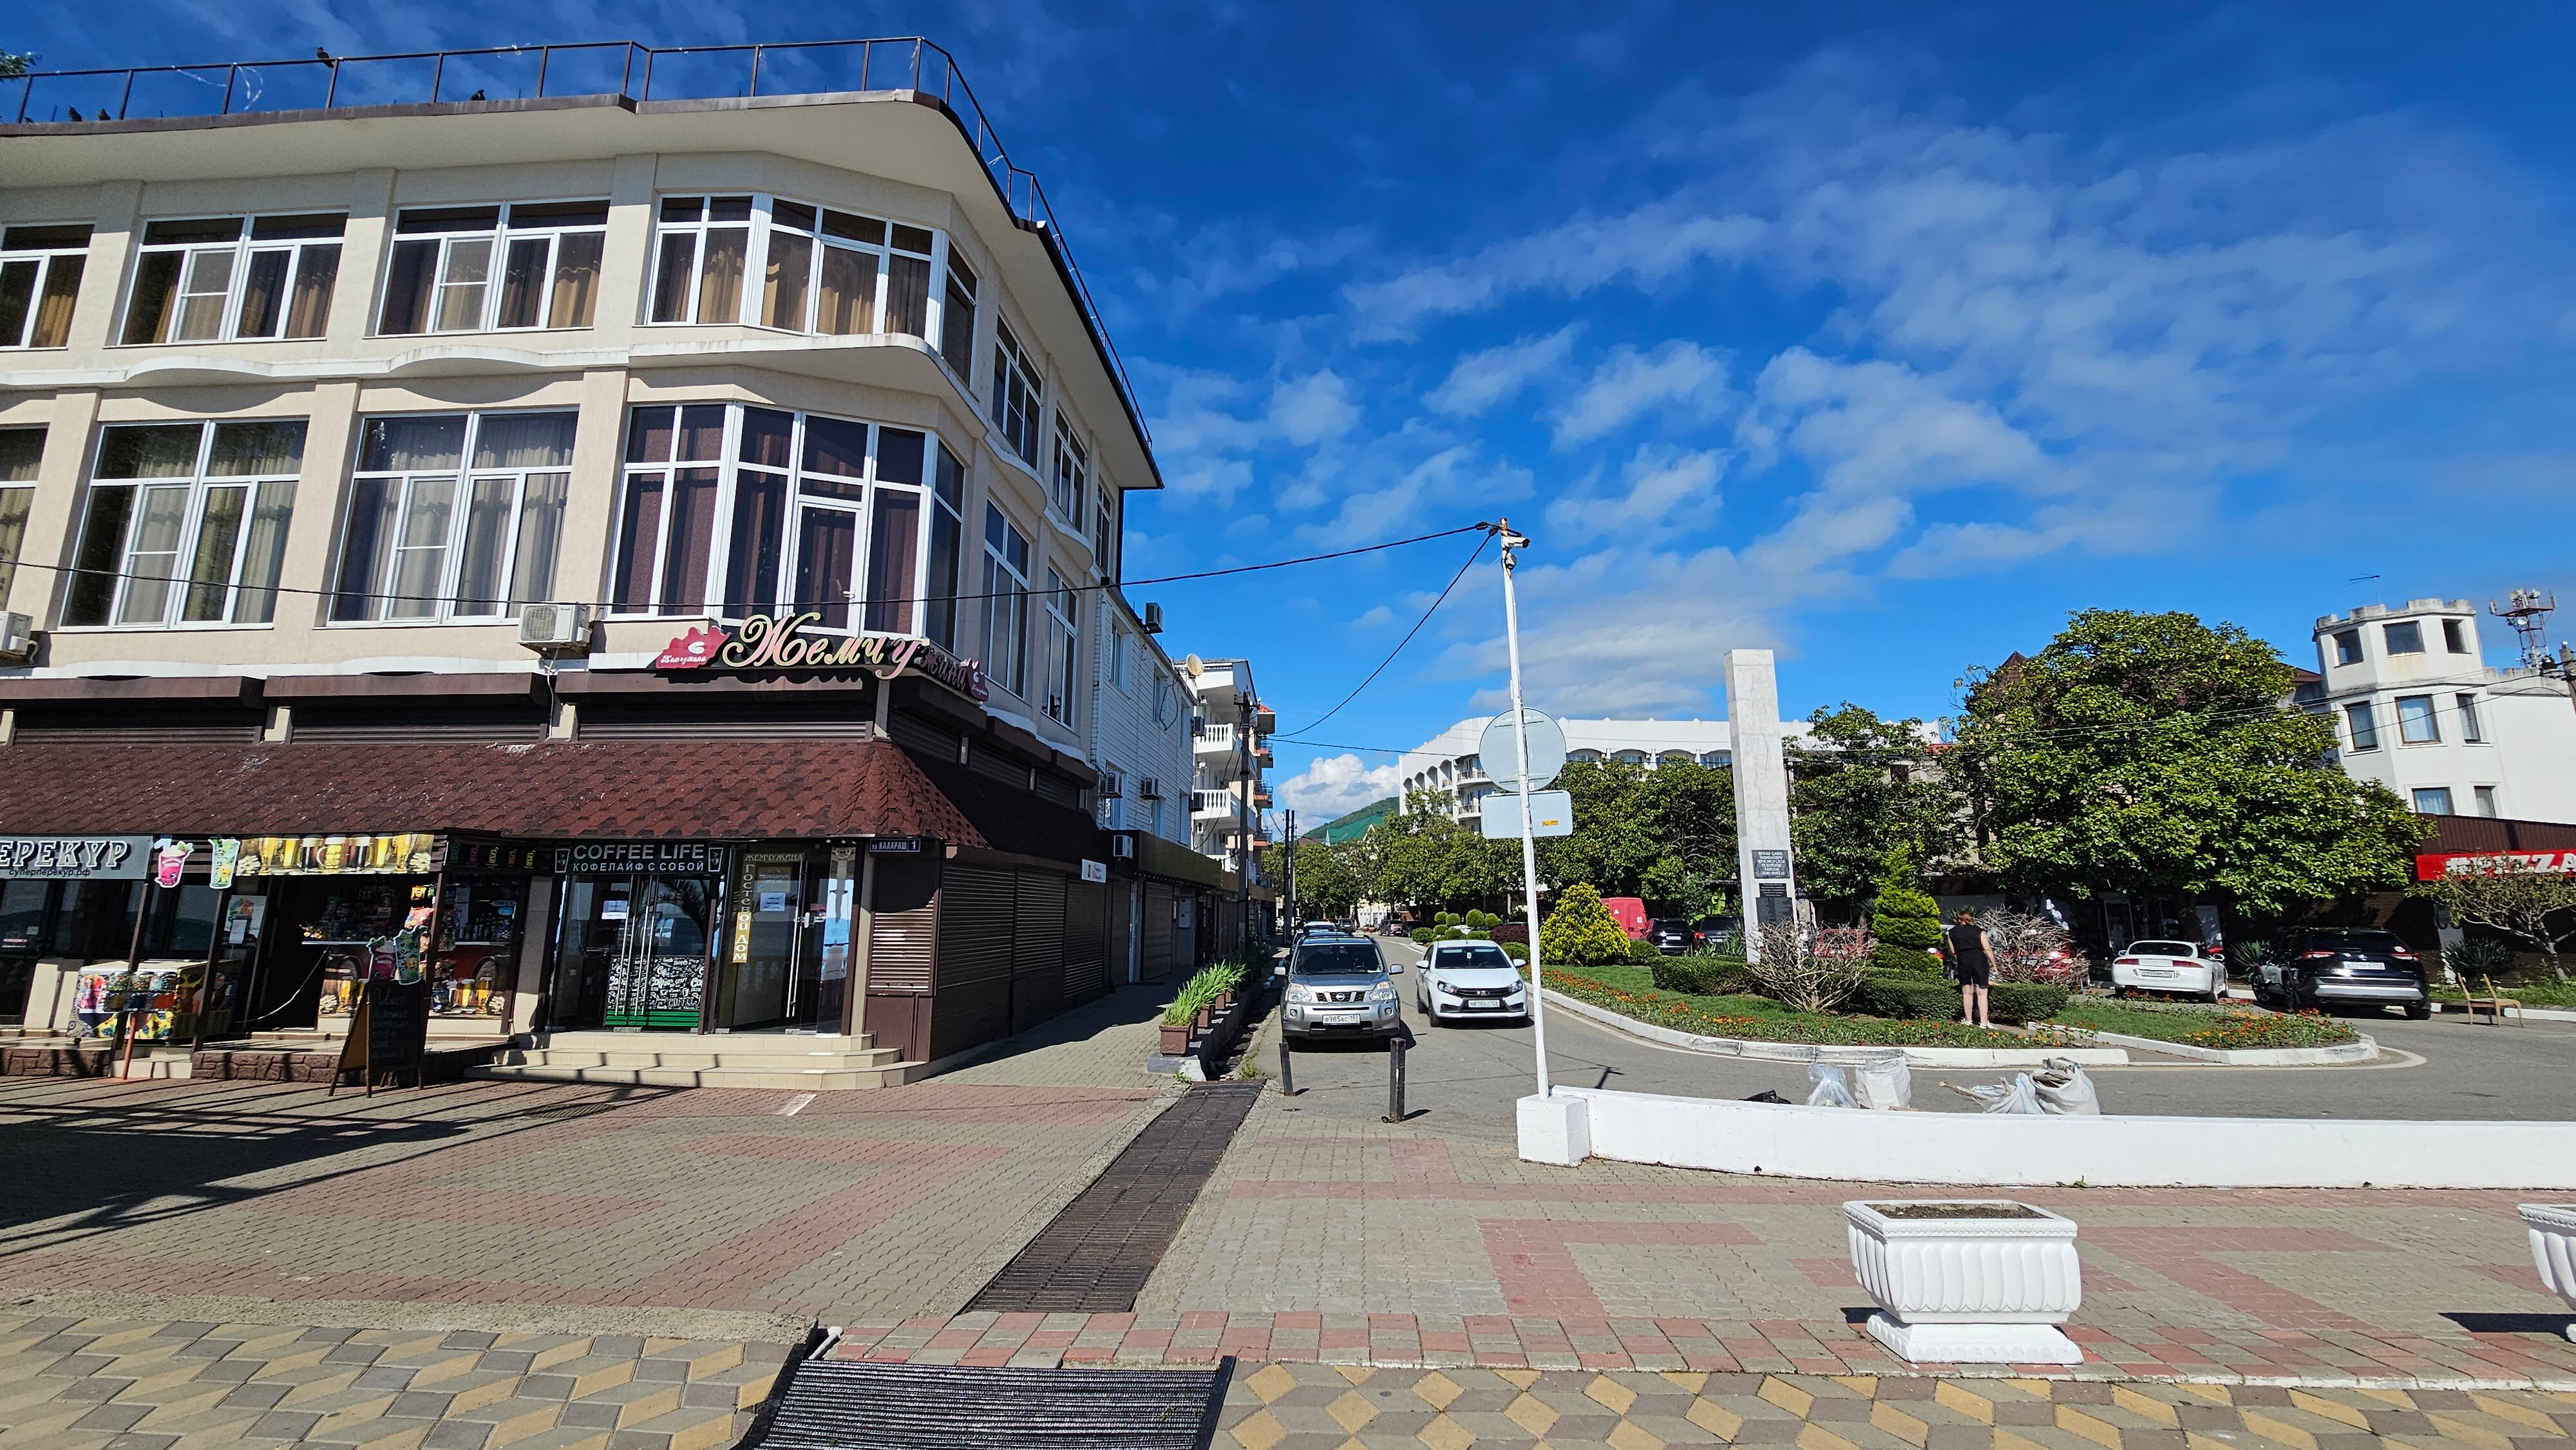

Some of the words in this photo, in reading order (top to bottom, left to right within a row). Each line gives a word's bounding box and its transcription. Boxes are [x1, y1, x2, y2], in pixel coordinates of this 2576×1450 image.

[878, 842, 907, 850] КАЛАРАШ
[911, 840, 916, 850] 1
[573, 844, 655, 860] COFFEE
[660, 843, 705, 859] LIFE
[573, 860, 644, 871] КОФЕЛАЙФ
[648, 862, 656, 871] С
[659, 860, 704, 871] СОБОЙ
[9, 868, 91, 878] суперперекур.рф
